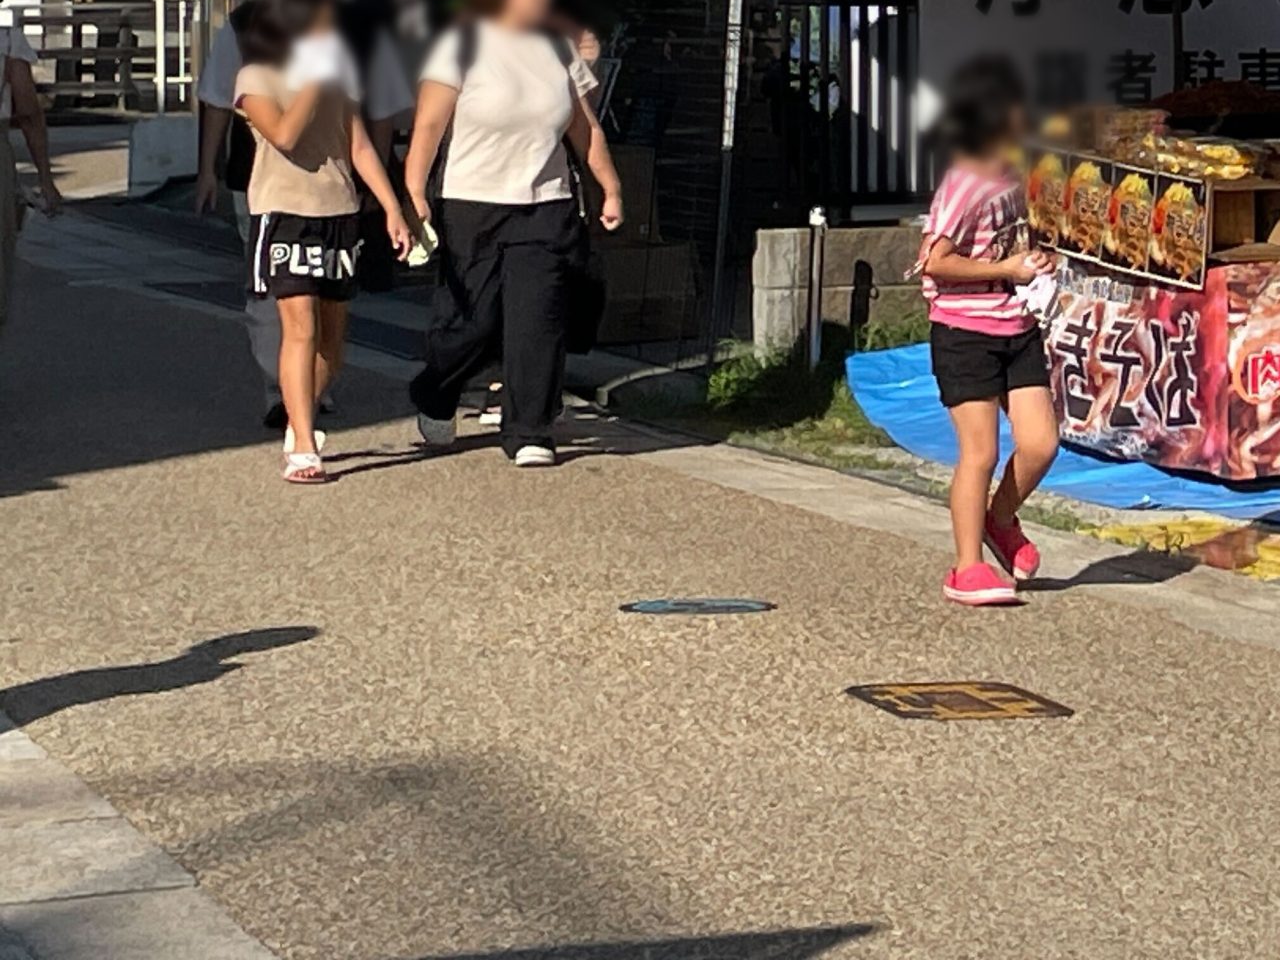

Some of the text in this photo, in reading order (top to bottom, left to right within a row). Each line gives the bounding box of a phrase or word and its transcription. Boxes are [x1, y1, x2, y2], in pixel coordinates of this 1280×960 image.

[269, 241, 360, 280] PLEIN
[1054, 310, 1199, 428] きそば
